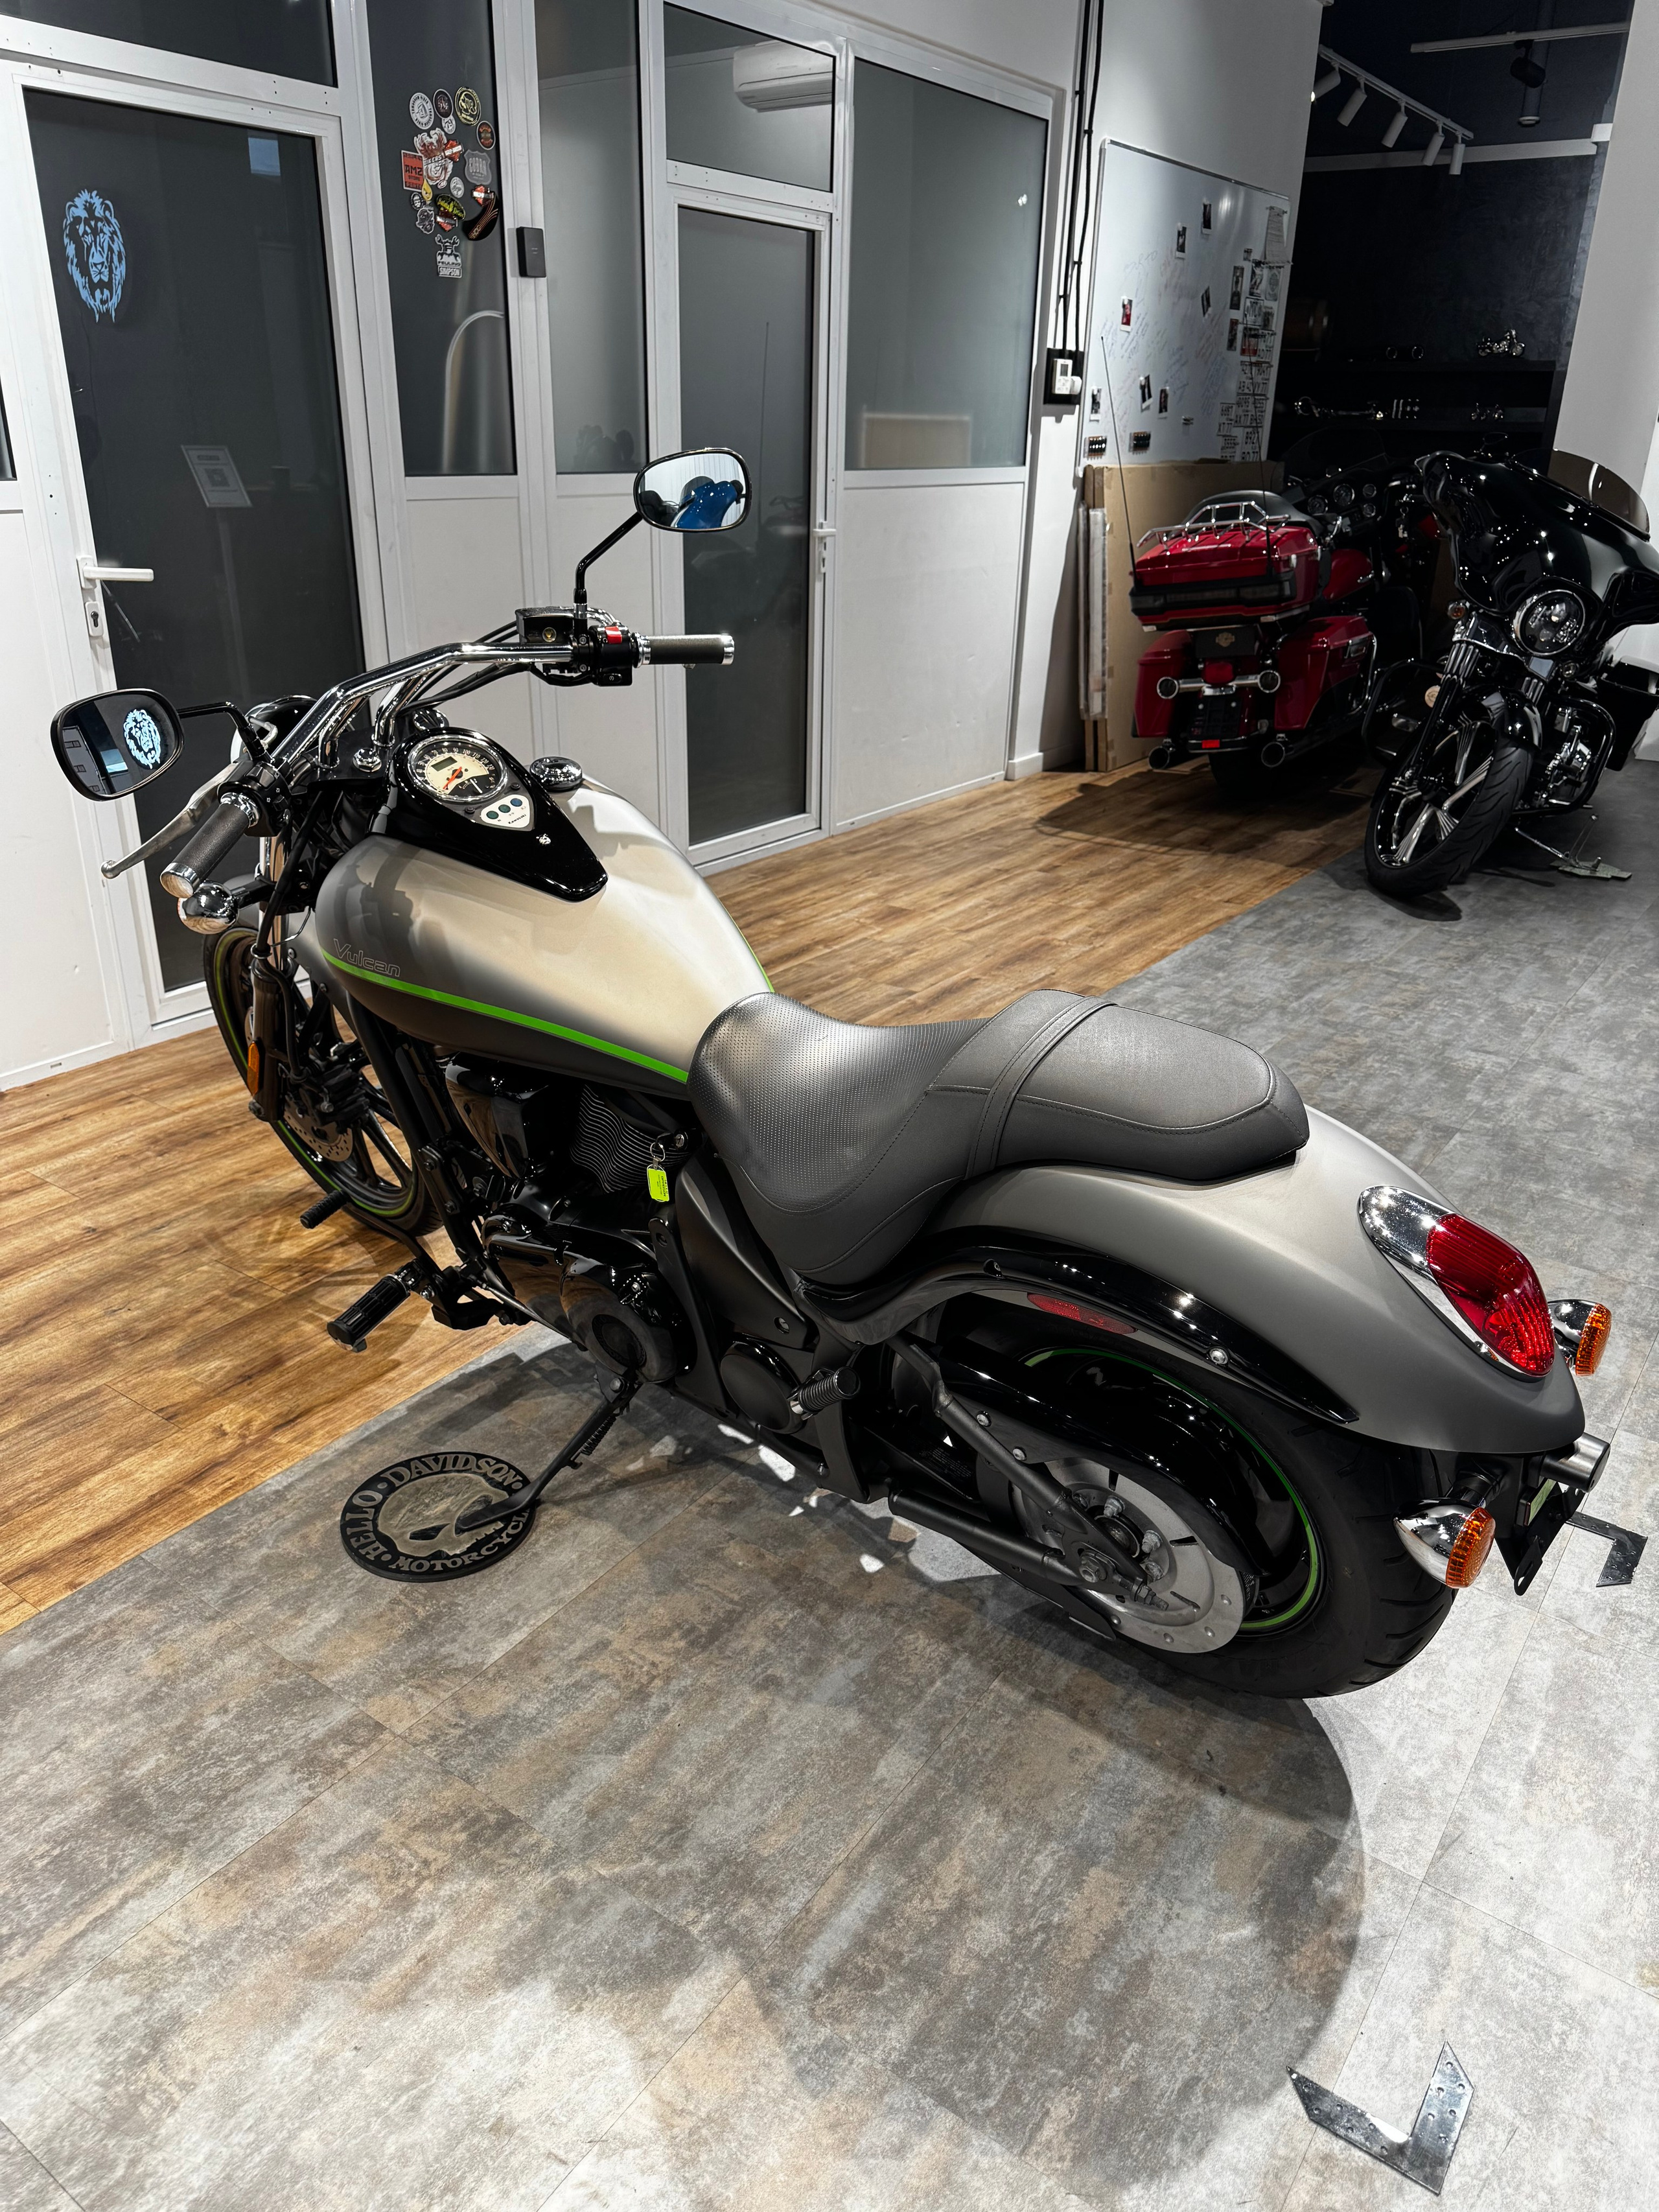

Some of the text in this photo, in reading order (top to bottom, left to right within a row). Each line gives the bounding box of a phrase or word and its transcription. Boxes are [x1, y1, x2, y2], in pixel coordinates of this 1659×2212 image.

[404, 165, 423, 176] AMZ
[439, 267, 460, 276] SIMPSON
[333, 938, 400, 977] Vulcan
[345, 1454, 523, 1561] HELLO DAVIDSON
[389, 1511, 529, 1572] MOTORCYCL
